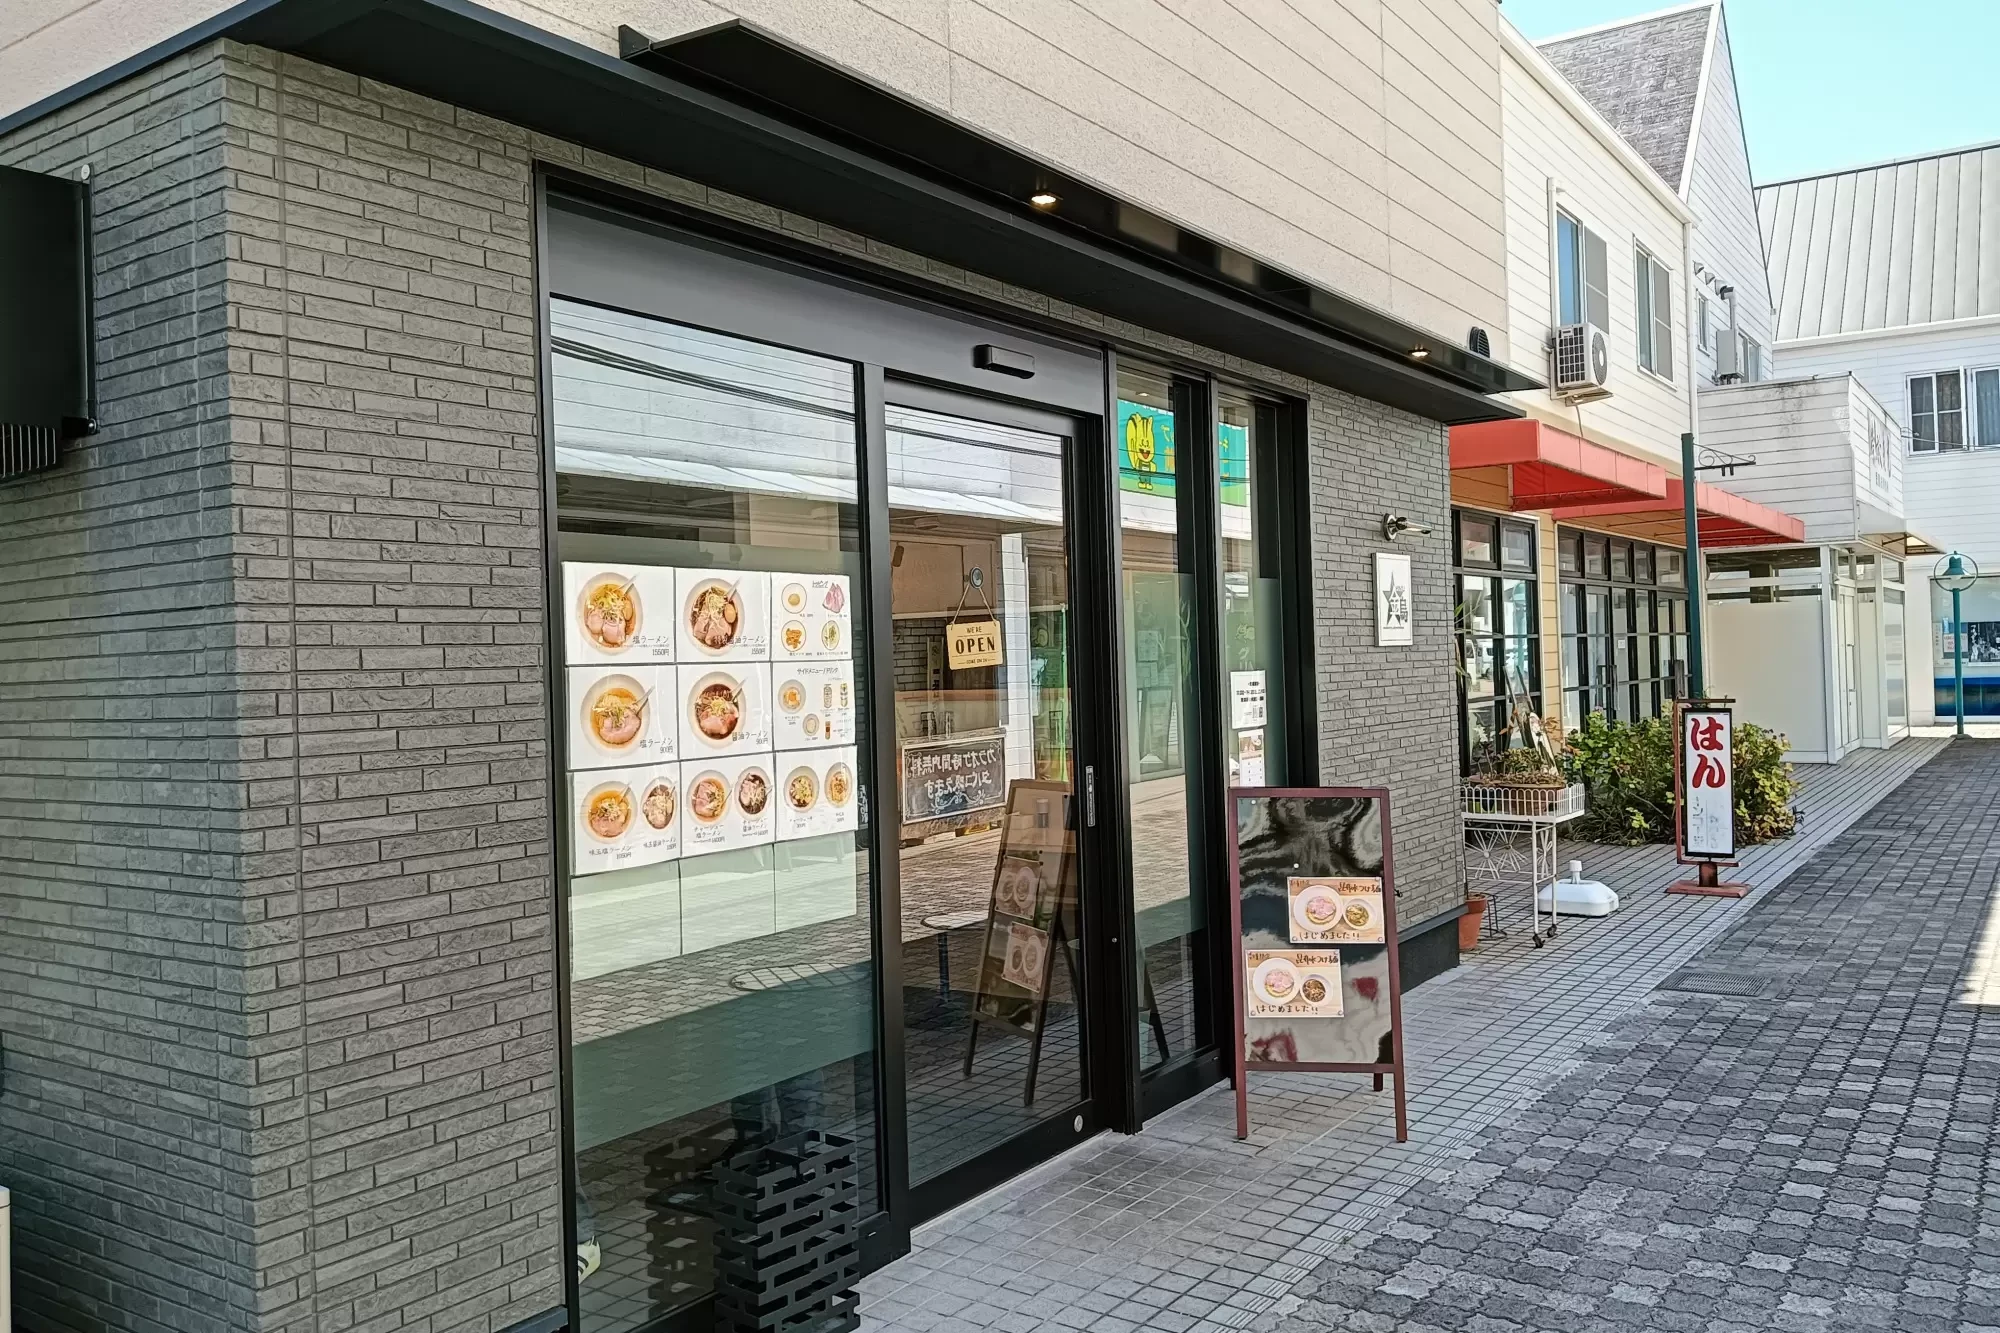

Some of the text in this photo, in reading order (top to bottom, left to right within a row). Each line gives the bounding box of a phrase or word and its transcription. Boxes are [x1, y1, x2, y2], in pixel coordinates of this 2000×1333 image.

[955, 637, 995, 654] OPEN
[639, 737, 673, 748] 塩ラーメン
[731, 730, 768, 741] 醤油ラーメン
[1691, 716, 1726, 789] はん
